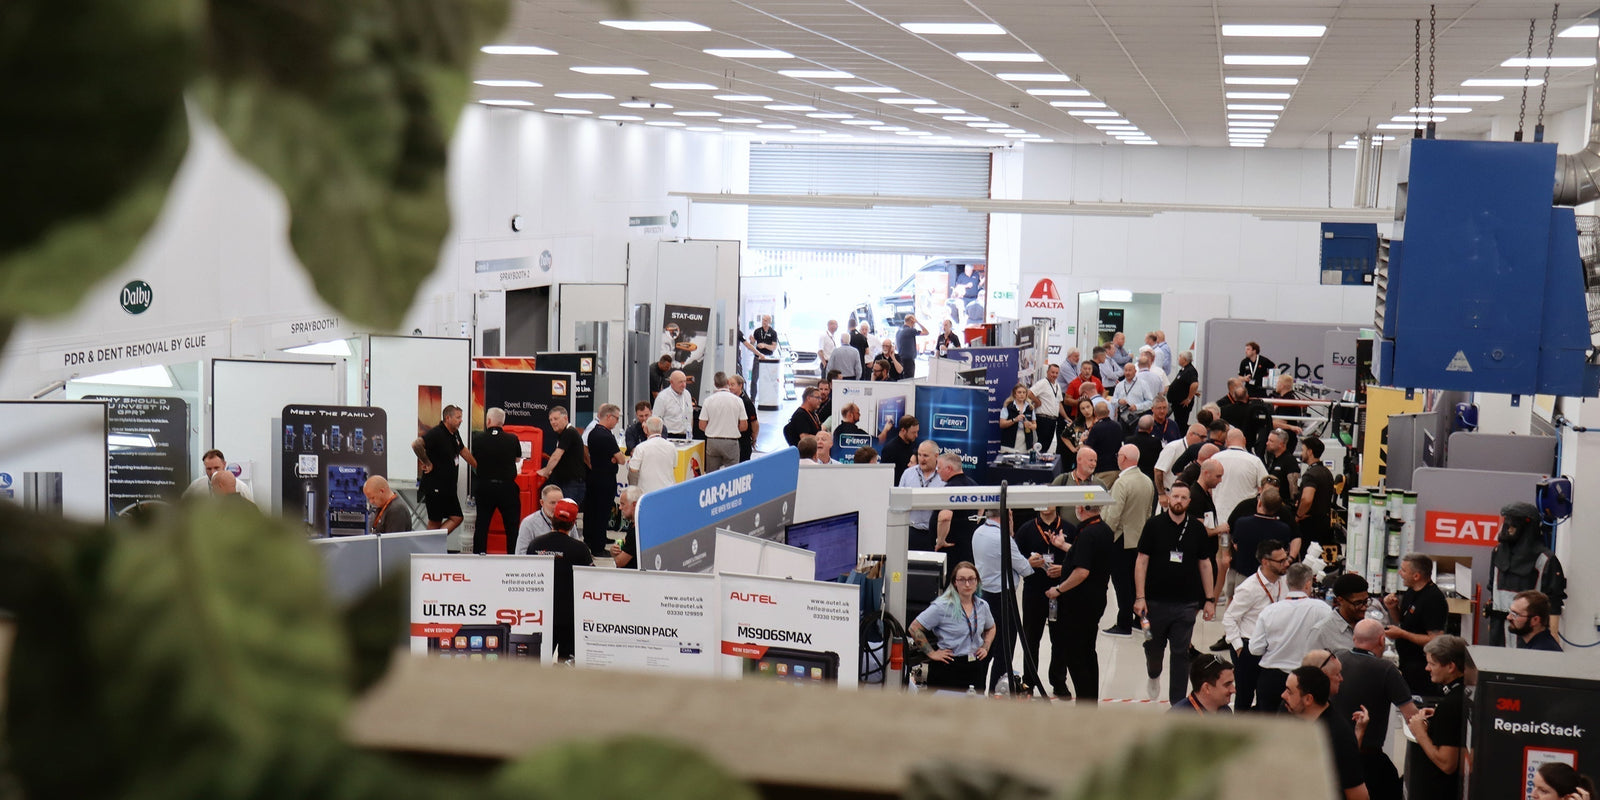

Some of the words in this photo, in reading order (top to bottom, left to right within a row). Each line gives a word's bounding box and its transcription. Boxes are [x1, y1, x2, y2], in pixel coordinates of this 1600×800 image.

[123, 283, 150, 308] Dalby
[1025, 301, 1064, 309] AXALTA
[672, 312, 703, 320] STAT-GUN
[291, 319, 334, 334] SPRAYBOOTH
[335, 318, 339, 329] 1
[64, 350, 84, 366] PDR
[88, 350, 94, 362] &
[97, 346, 124, 362] DENT
[126, 341, 168, 358] REMOVAL
[171, 338, 182, 350] BY
[184, 335, 206, 349] GLUE
[504, 401, 520, 409] Speed.
[523, 402, 548, 411] Efficiency.
[699, 474, 751, 508] CAR-O-LINER
[422, 573, 471, 582] AUTEL
[583, 591, 630, 602] AUTEL
[730, 592, 777, 604] AUTEL
[423, 604, 466, 616] ULTRA
[469, 604, 486, 616] S2
[807, 605, 849, 614] hello@autel.uk
[583, 622, 595, 632] EV
[596, 623, 650, 635] EXPANSION
[652, 627, 678, 638] PACK
[738, 626, 812, 644] MS906SMAX
[1496, 698, 1520, 711] 3M
